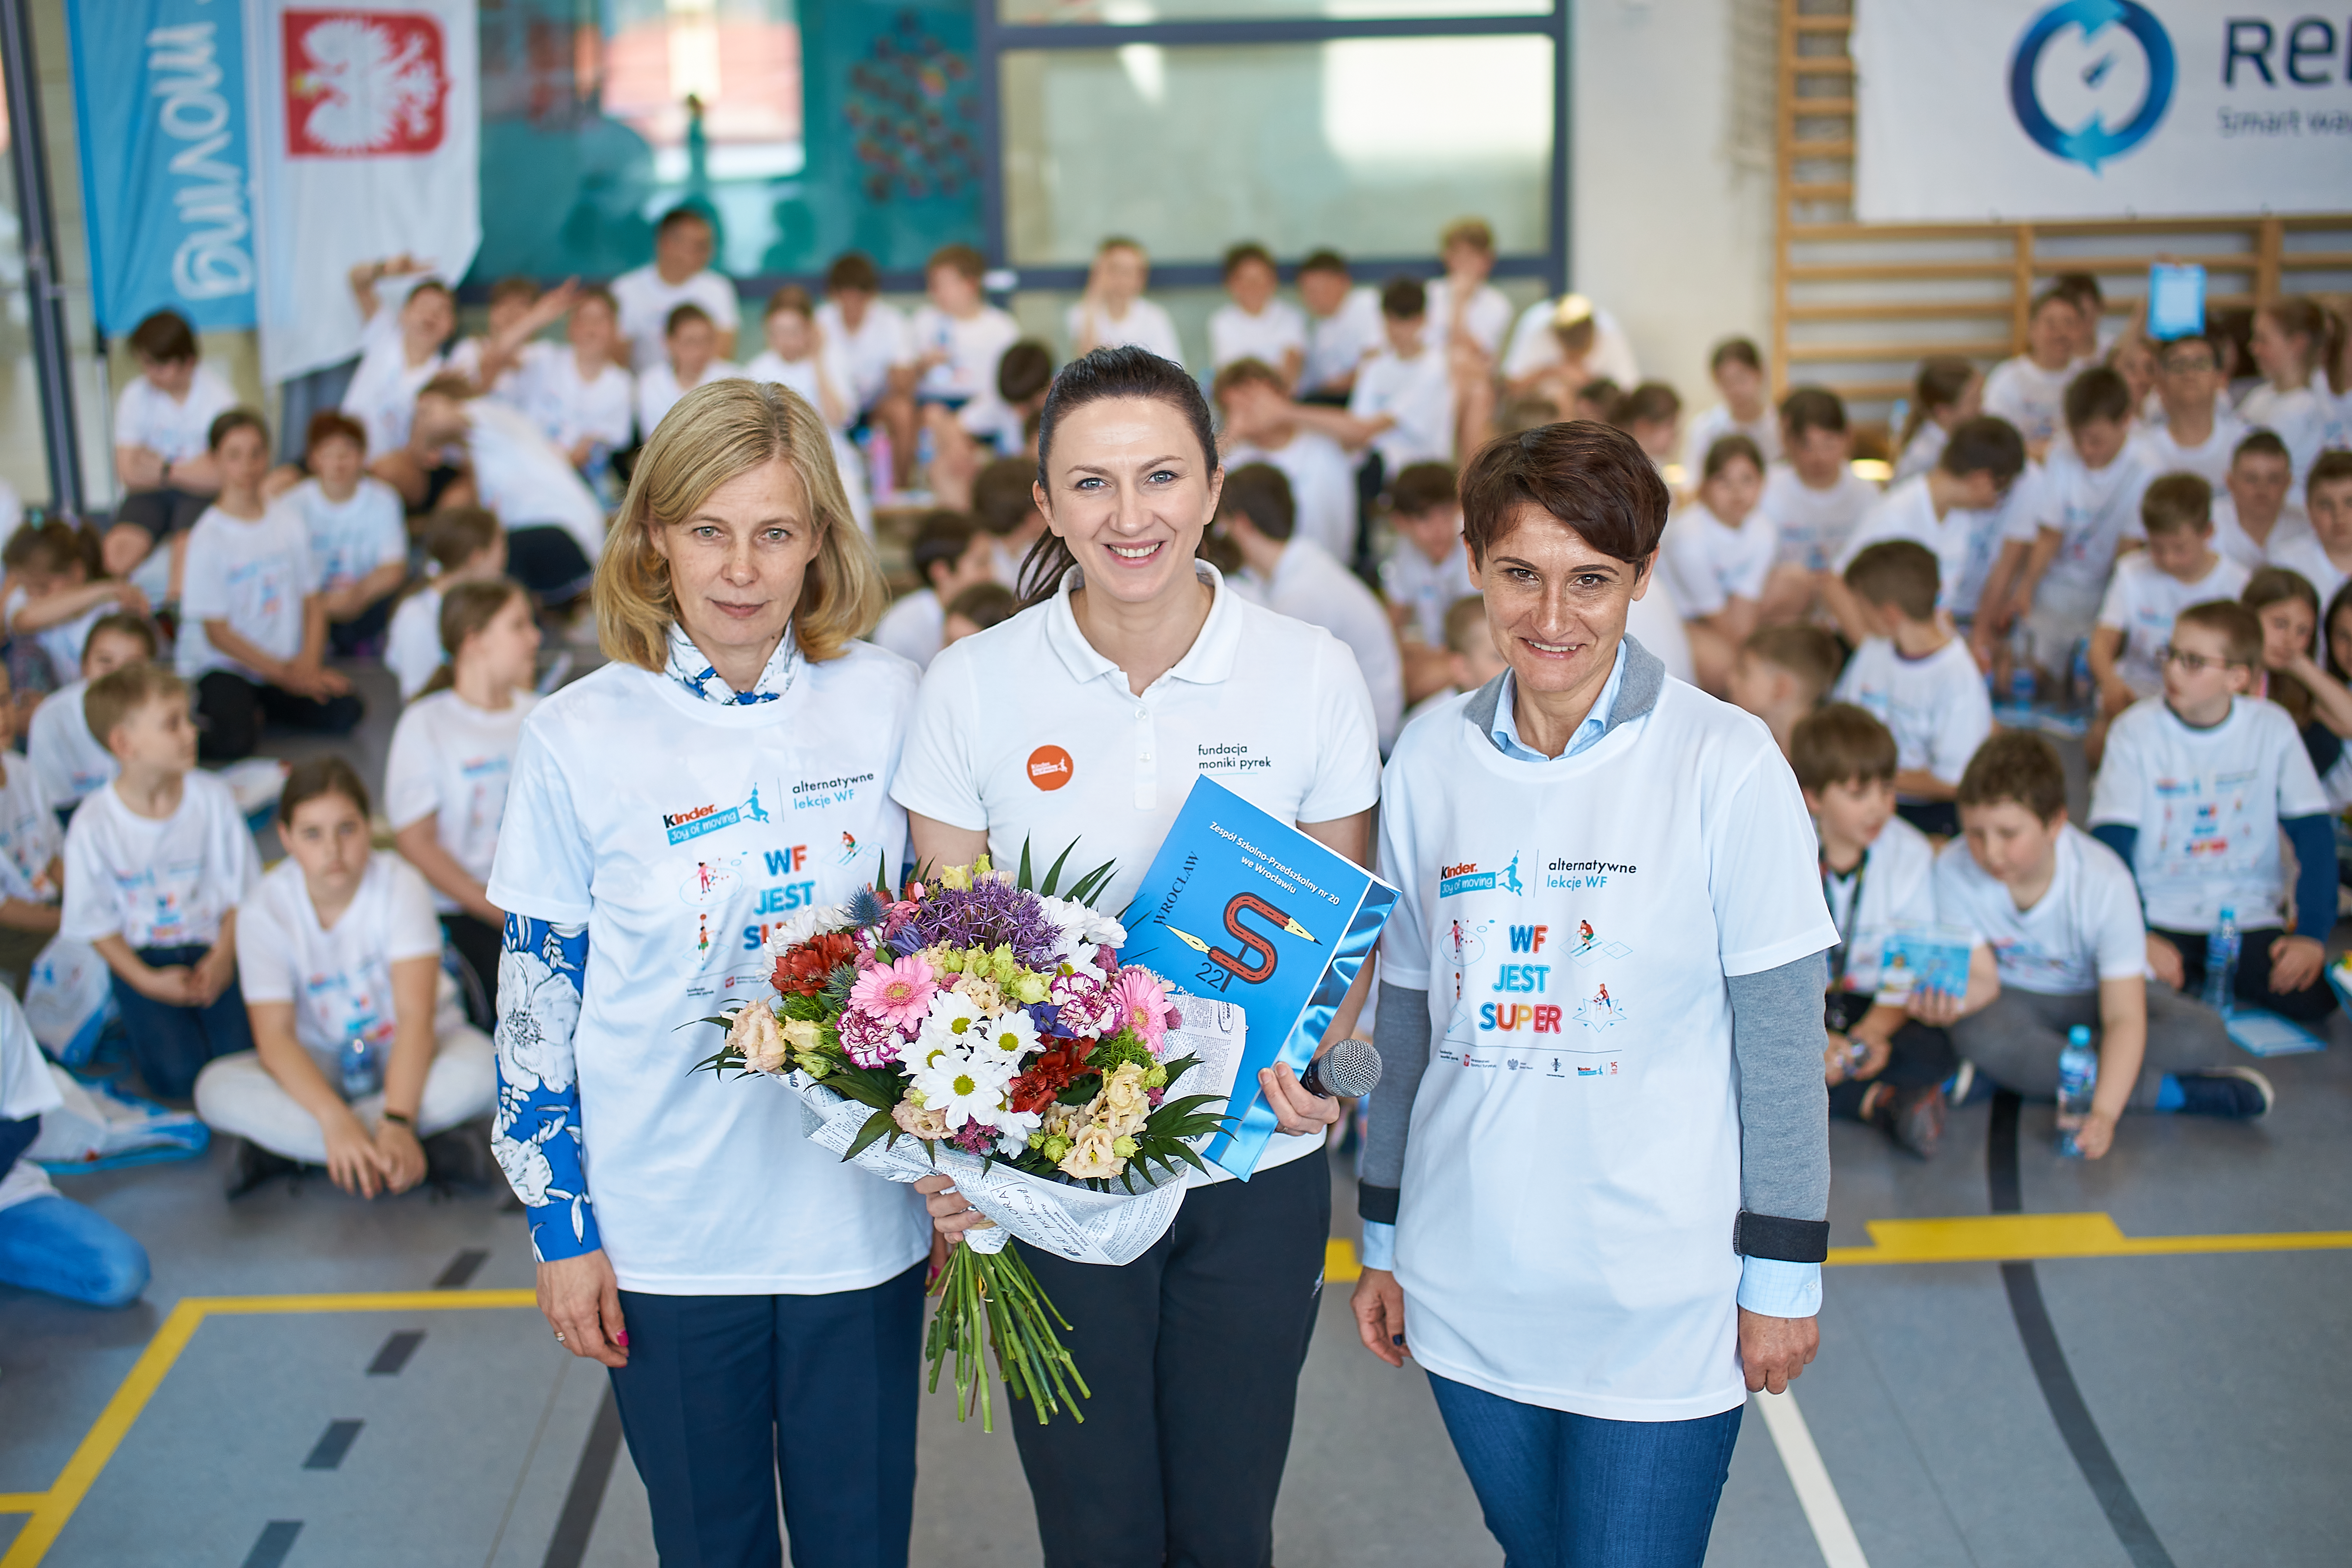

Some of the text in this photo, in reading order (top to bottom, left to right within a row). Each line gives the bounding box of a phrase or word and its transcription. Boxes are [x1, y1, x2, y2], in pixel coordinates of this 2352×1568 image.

[2222, 16, 2352, 87] Re
[1199, 743, 1247, 756] fundacja
[1199, 756, 1271, 770] moniki pyrek
[793, 773, 874, 793] alternatywne
[794, 789, 854, 810] lekcje WF
[671, 812, 737, 842] Joy of moving
[763, 844, 807, 877] WF
[1209, 821, 1340, 905] Zespół Szkolno-Przedszkolny nr 20
[1241, 856, 1297, 894] we Wrocławiu
[1549, 858, 1636, 874] alternatywne
[753, 879, 816, 916] JEST
[1153, 851, 1199, 926] WROCŁAW
[1442, 876, 1493, 894] Joy of moving
[1547, 875, 1608, 891] lekcje WF
[1509, 925, 1549, 954] WF
[1195, 962, 1224, 989] 22
[1492, 963, 1551, 994] JEST
[1479, 1002, 1563, 1034] SUPER
